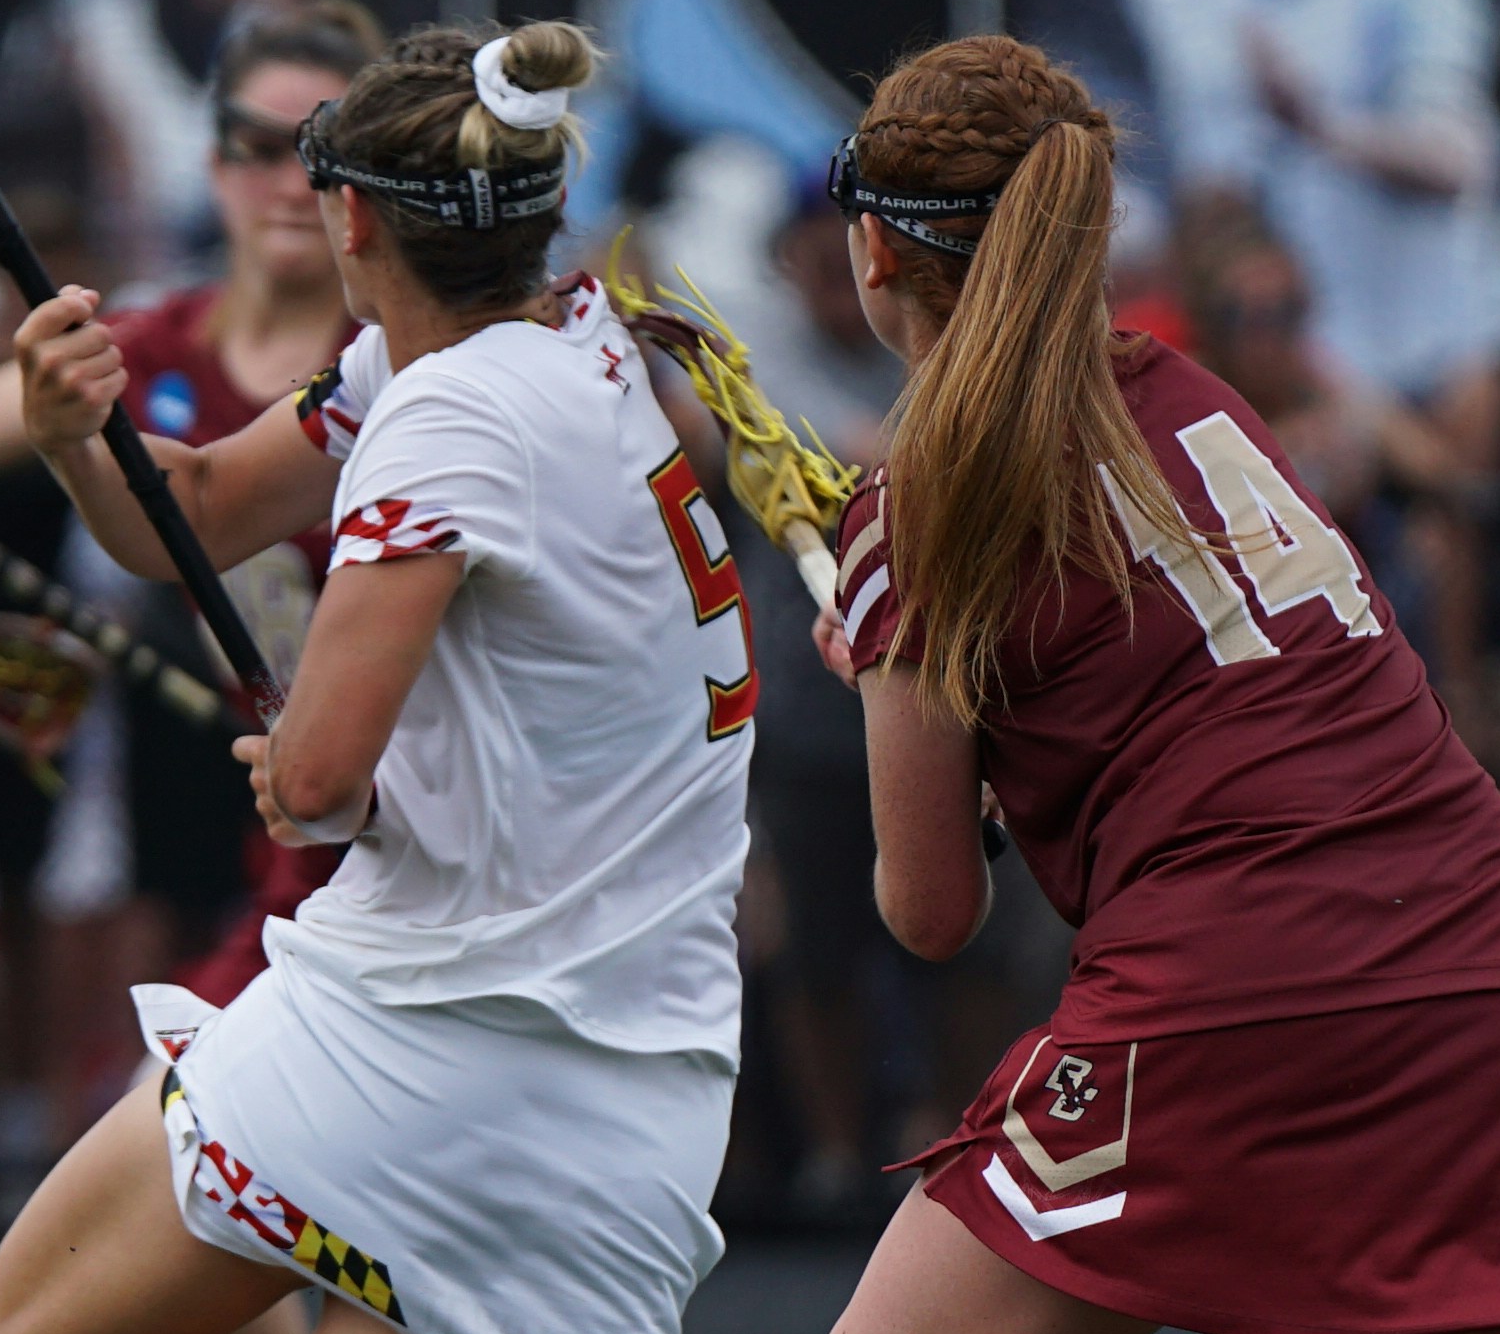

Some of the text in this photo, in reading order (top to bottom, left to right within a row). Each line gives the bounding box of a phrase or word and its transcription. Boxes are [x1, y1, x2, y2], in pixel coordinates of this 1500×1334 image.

[331, 164, 427, 193] ARMOUR
[880, 195, 977, 211] ARMOUR
[646, 447, 760, 743] 5
[1096, 410, 1384, 667] 14
